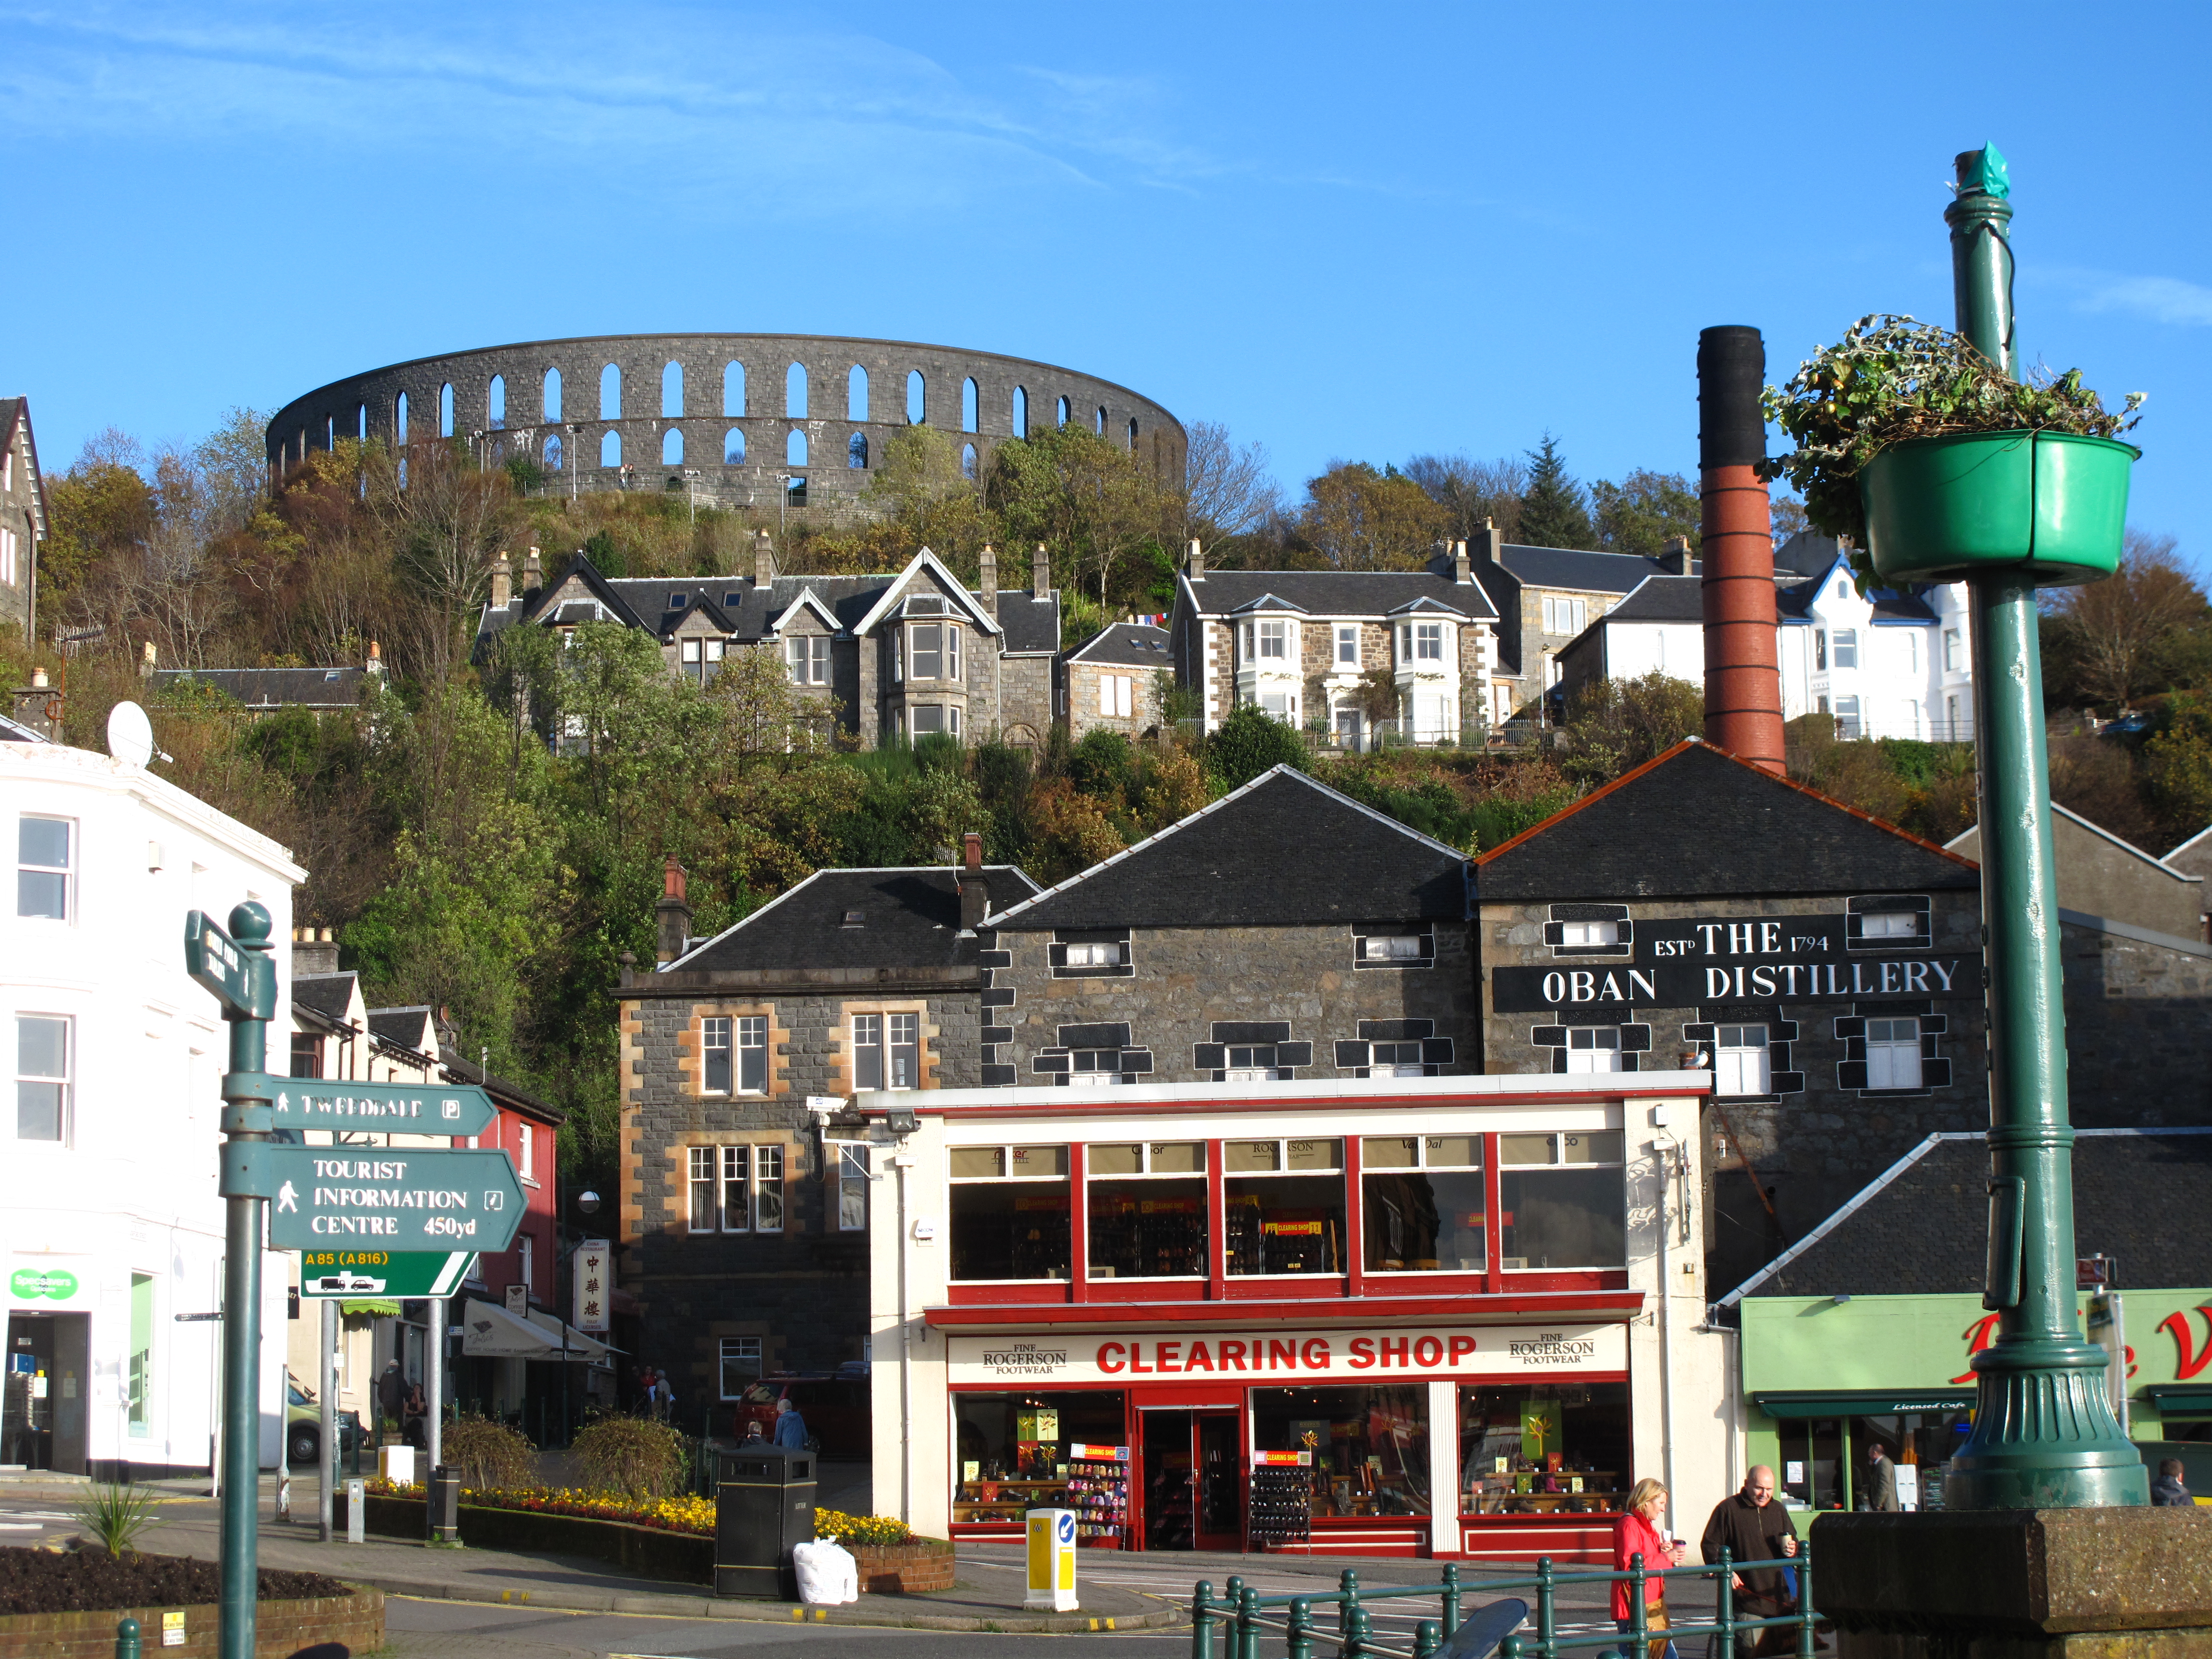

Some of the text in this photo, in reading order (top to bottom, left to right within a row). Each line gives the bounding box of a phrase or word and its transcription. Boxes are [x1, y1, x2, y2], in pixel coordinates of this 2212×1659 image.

[1697, 922, 1782, 955] THE
[1790, 936, 1829, 953] 1794
[1543, 960, 1960, 1003] OBAN DISTILLERY
[301, 1095, 422, 1117] TWEEDDALE
[1253, 1142, 1313, 1153] ROGRSON
[1547, 1137, 1578, 1146] eco
[1132, 1145, 1165, 1155] Gor
[313, 1160, 407, 1180] TOURIST
[314, 1188, 467, 1209] INFORMATION
[312, 1216, 476, 1239] CENTRE 450yd
[306, 1253, 335, 1266] A85
[15, 1274, 71, 1286] Specsavers
[584, 1255, 600, 1316] 中華樓
[1540, 1333, 1563, 1341] FINE
[1013, 1344, 1036, 1352] FINE
[1096, 1335, 1477, 1374] CLEARING SHOP
[1509, 1342, 1594, 1356] ROGERSON
[983, 1352, 1066, 1366] ROGERSON
[1523, 1355, 1582, 1364] FOOTWEAR
[996, 1365, 1053, 1374] FOOTWEAR
